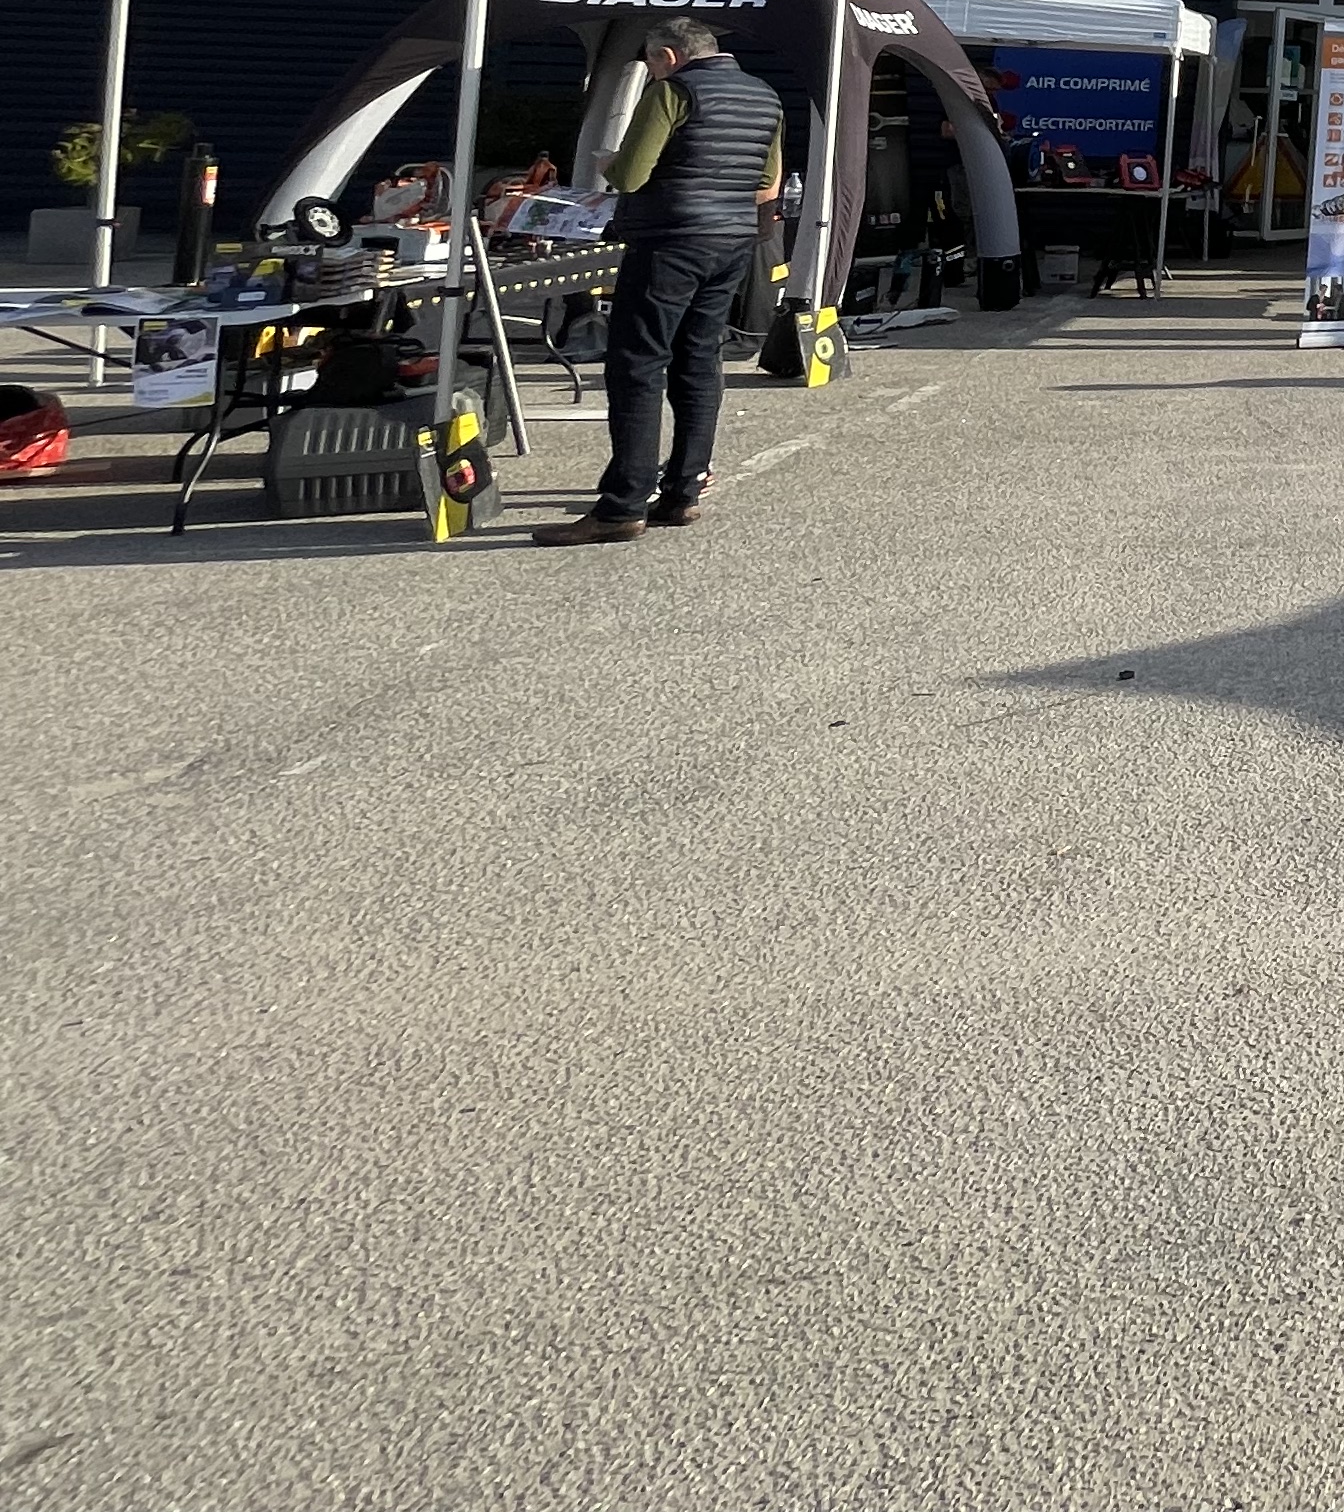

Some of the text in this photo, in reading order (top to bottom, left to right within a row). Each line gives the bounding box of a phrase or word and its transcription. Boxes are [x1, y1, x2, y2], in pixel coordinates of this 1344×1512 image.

[1026, 76, 1151, 92] AIR COMPRIMÉ
[1022, 114, 1154, 131] ÉLECTROPORTATIF
